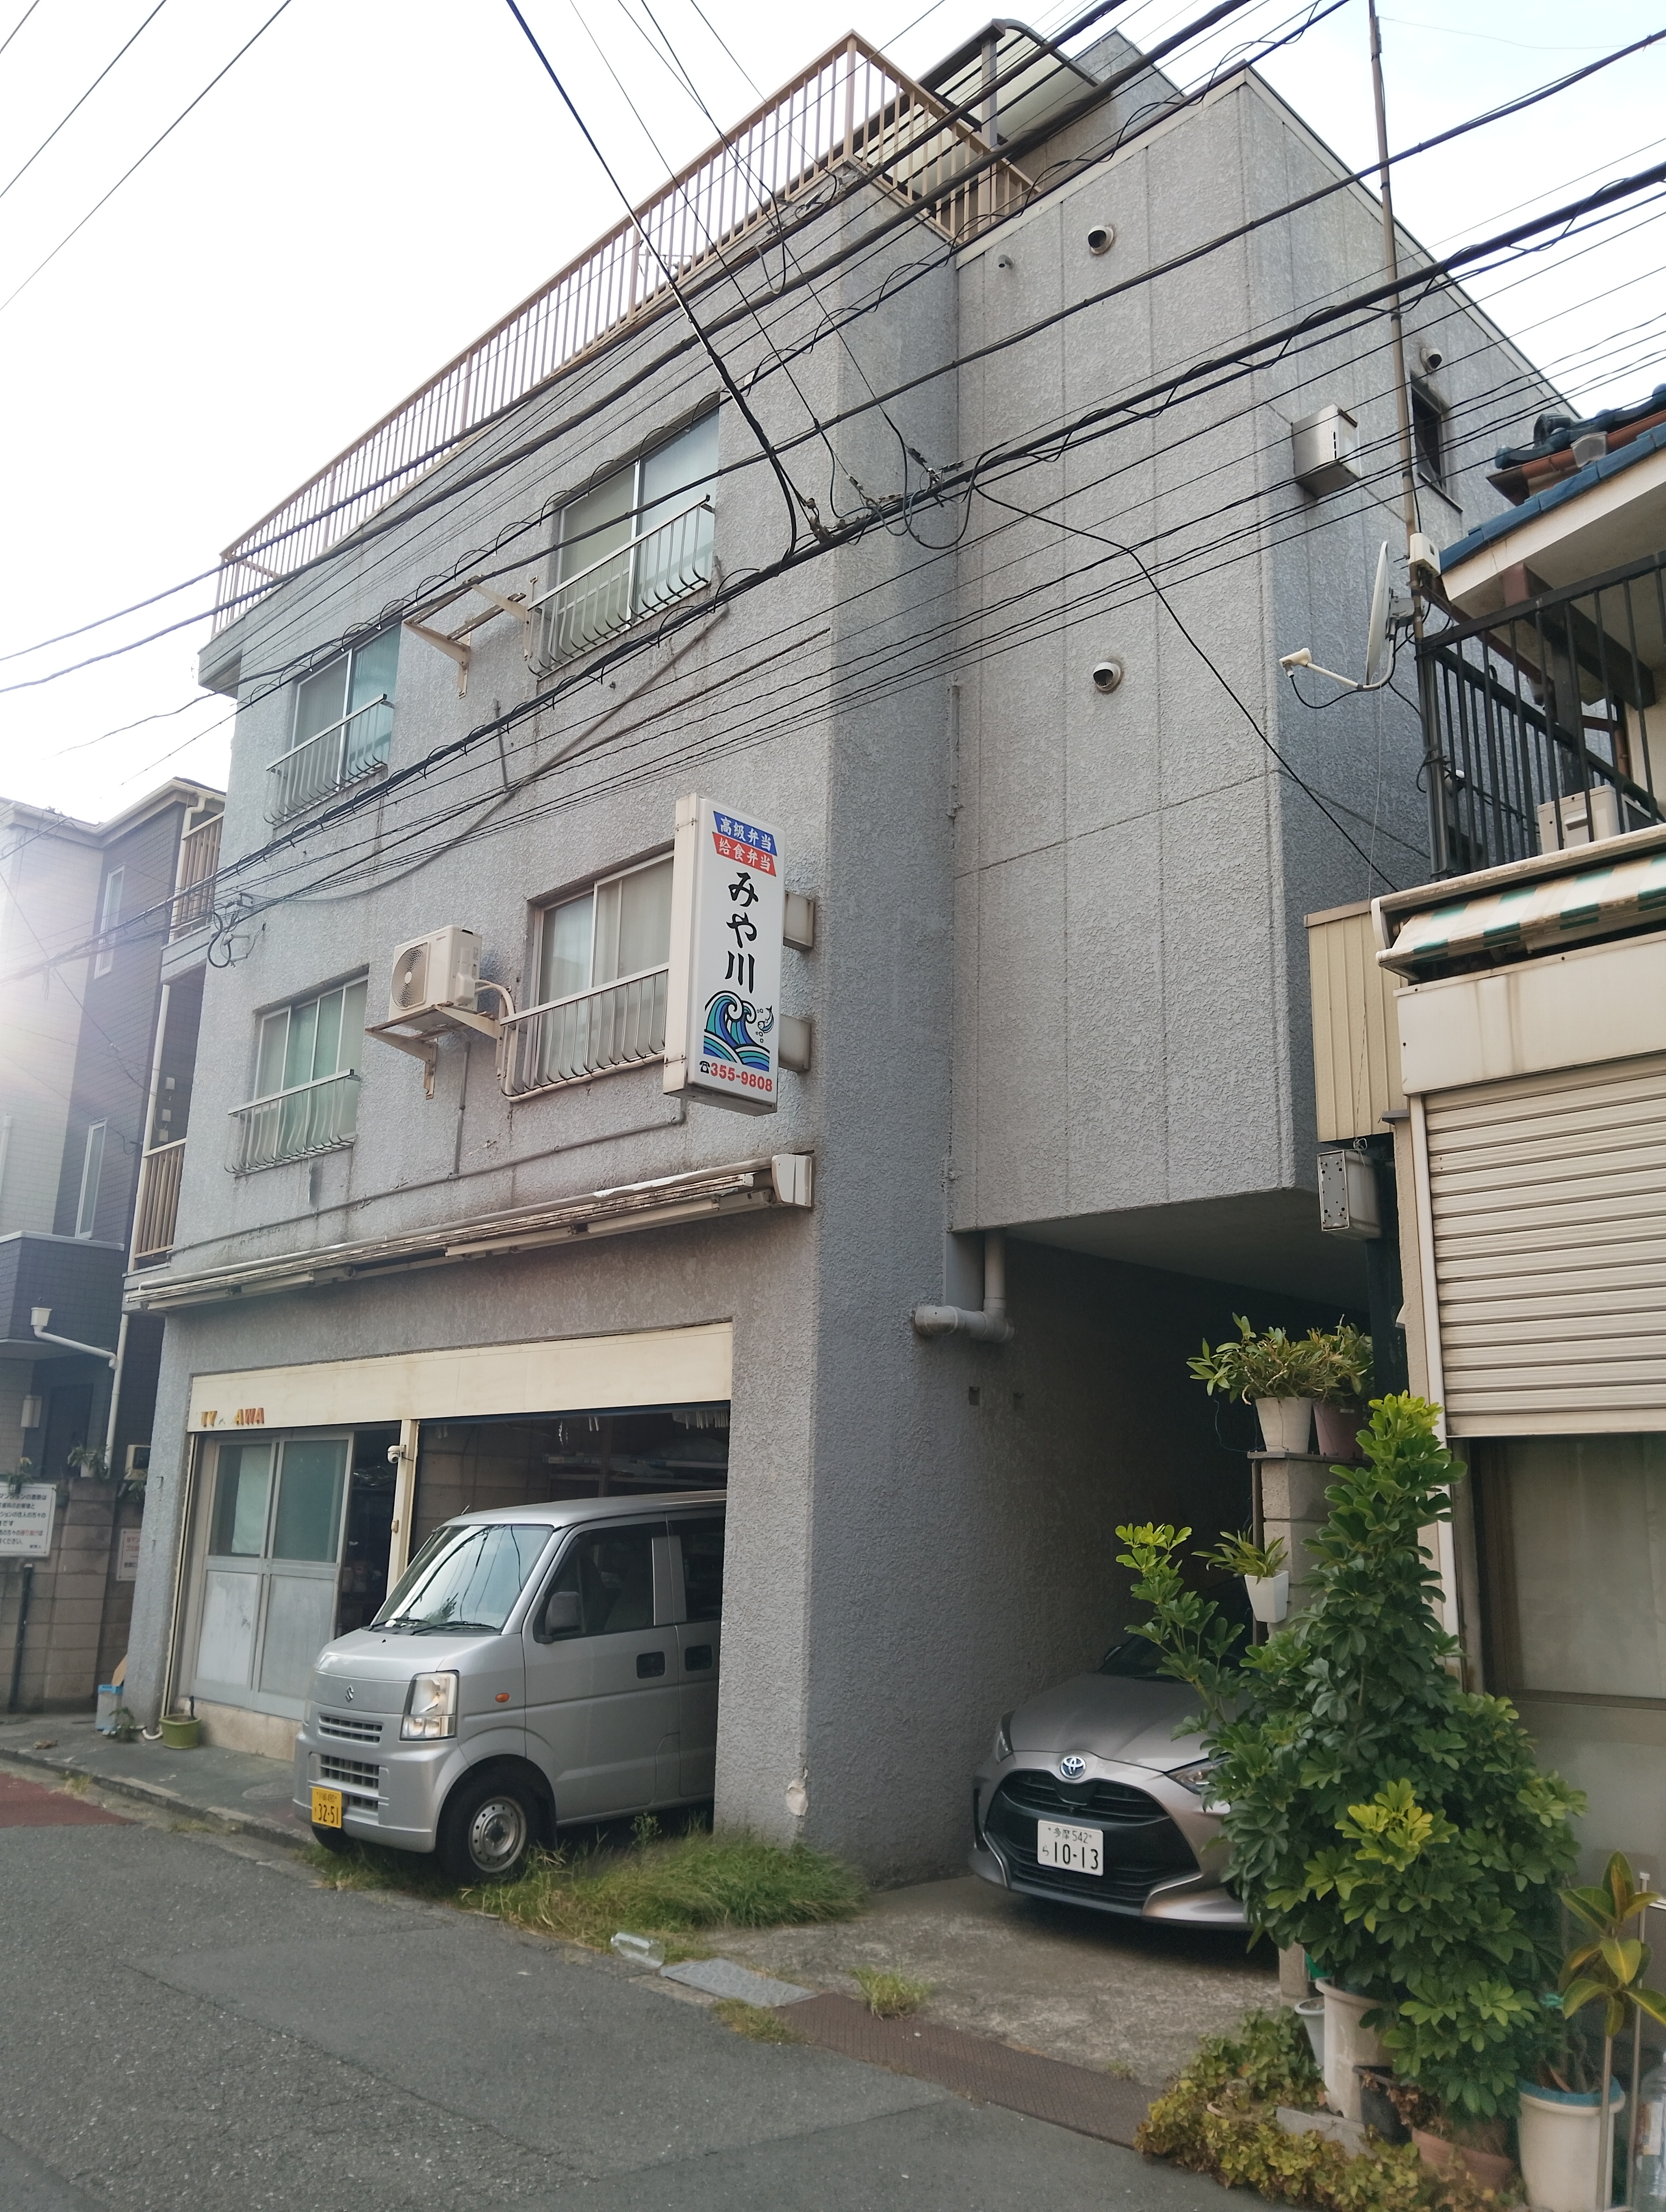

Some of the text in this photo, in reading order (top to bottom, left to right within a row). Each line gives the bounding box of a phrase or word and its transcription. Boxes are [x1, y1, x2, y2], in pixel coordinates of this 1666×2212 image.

[720, 816, 772, 852] 高級弁当
[719, 837, 771, 872] 給食弁当
[725, 872, 759, 994] みや川
[710, 1063, 772, 1092] 355-9808
[1042, 1842, 1098, 1870] ら 10-13
